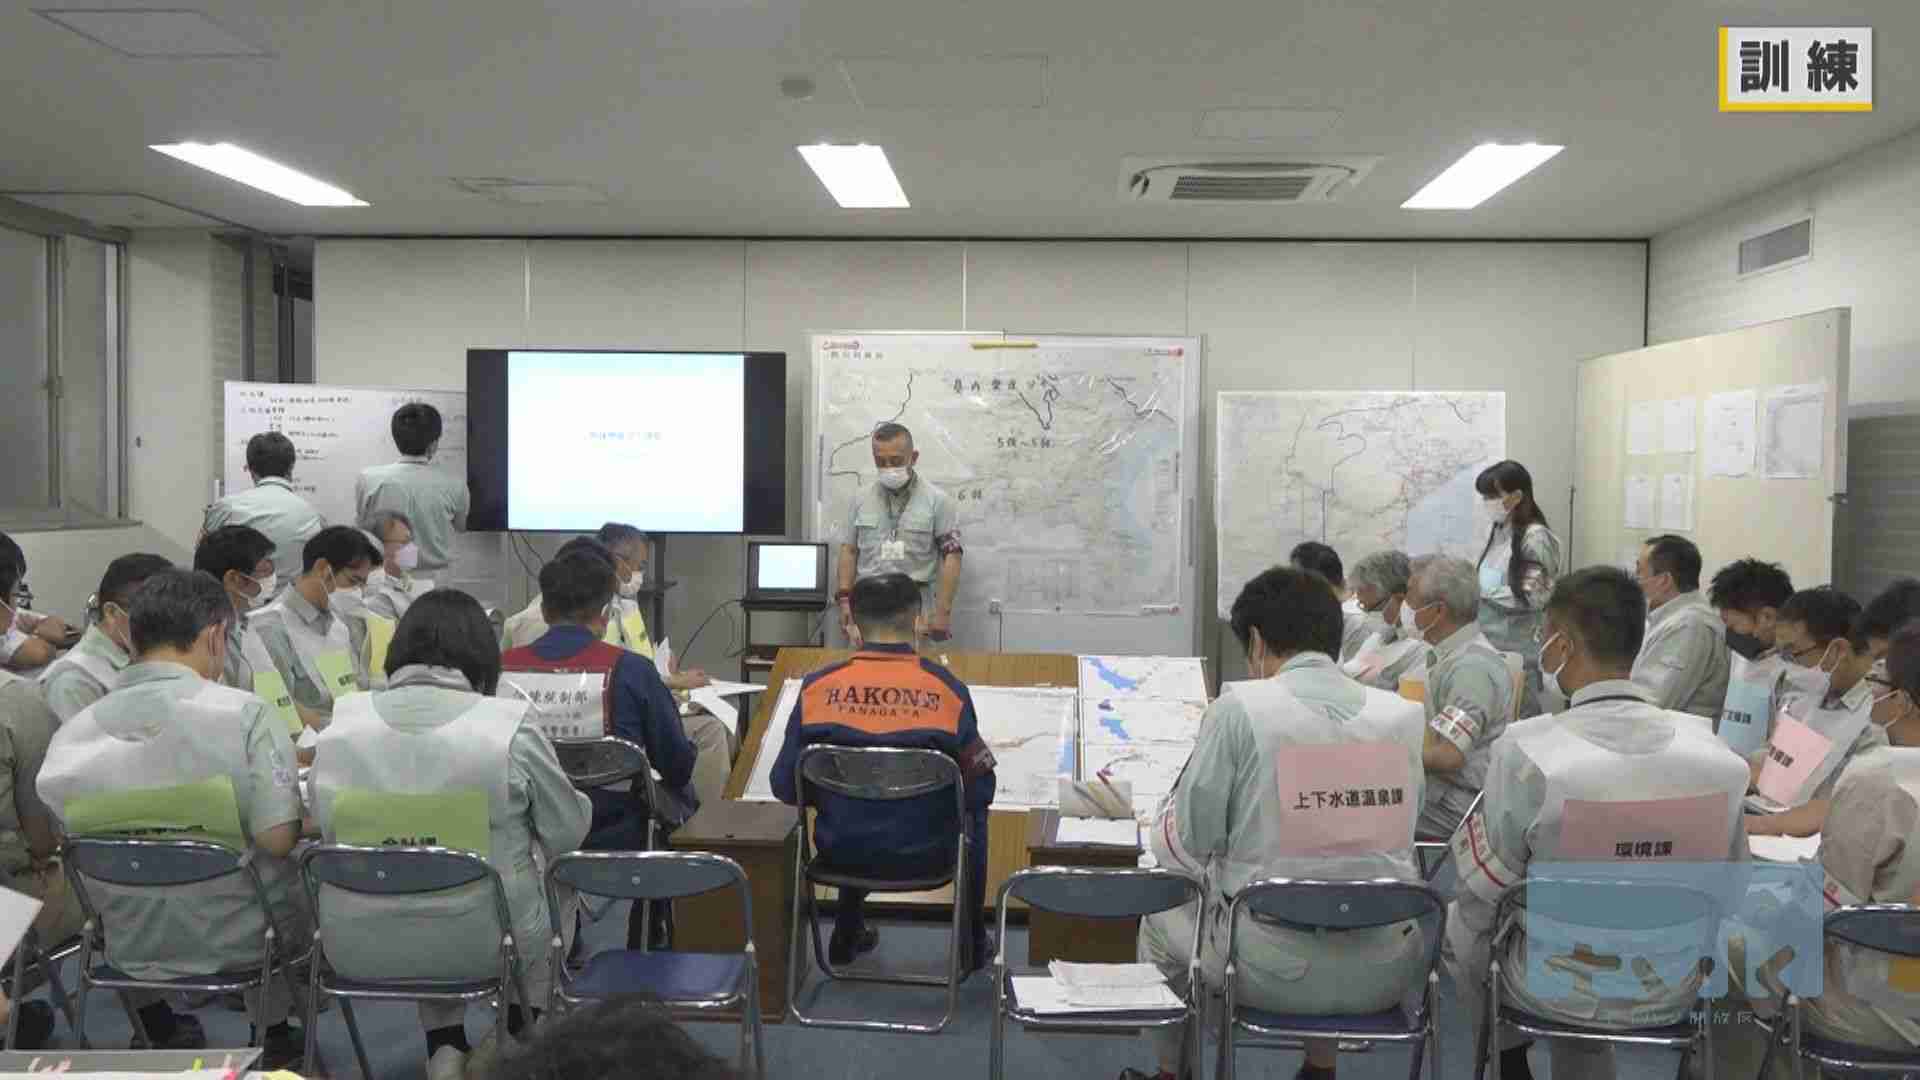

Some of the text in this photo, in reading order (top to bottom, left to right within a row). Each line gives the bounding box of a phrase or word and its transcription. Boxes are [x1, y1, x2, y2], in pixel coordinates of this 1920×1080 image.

[824, 685, 940, 712] HAKONE
[1293, 788, 1404, 811] 上下水道温泉課
[1614, 841, 1673, 857] 環境課
